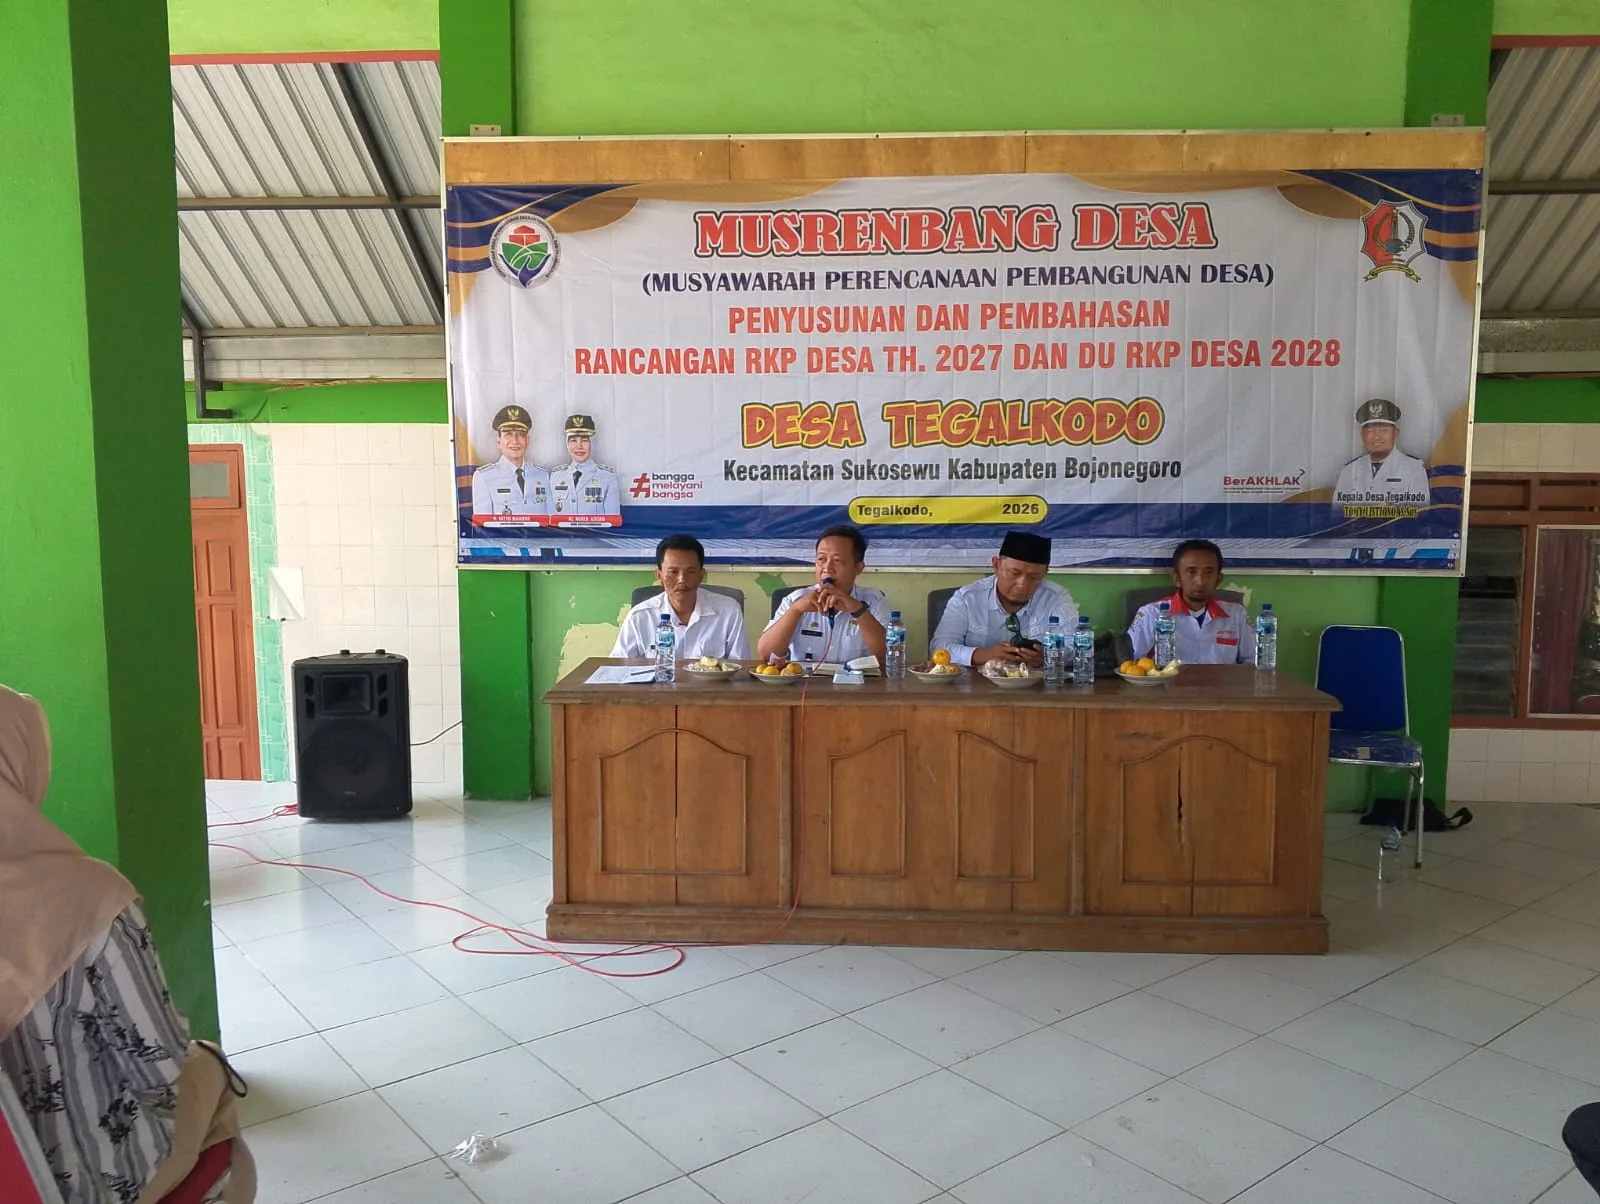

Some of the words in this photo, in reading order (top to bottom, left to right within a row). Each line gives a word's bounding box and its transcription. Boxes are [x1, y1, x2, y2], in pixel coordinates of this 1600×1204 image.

[694, 204, 1061, 257] MUSRENBANG
[1072, 202, 1218, 252] DESA
[642, 269, 816, 296] (MUSYAWARAH
[825, 267, 998, 293] PERENCANAAN
[1006, 265, 1192, 290] PEMBANGUNAN
[1201, 263, 1275, 288] DESA)
[729, 304, 906, 335] PENYUSUNAN
[916, 303, 970, 333] DAN
[980, 300, 1170, 331] PEMBAHASAN
[575, 347, 735, 376] RANCANGAN
[746, 346, 797, 375] RKP
[807, 345, 874, 374] DESA
[884, 344, 926, 373] TH.
[936, 343, 1003, 372] 2027
[1013, 342, 1069, 371] DAN
[1079, 342, 1116, 370] DU
[1126, 341, 1181, 370] RKP
[1191, 340, 1262, 369] DESA
[1271, 339, 1341, 367] 2028
[740, 402, 866, 449] DESA
[882, 397, 1166, 448] TEGALKODO
[652, 472, 695, 482] bangga
[723, 458, 835, 482] Kecamatan
[841, 458, 940, 482] Sukosewu
[948, 457, 1057, 482] Kabupaten
[1064, 456, 1182, 484] Bojonegoro
[652, 481, 703, 491] melayani
[1223, 476, 1300, 486] BerAKHLAK
[652, 491, 694, 500] bangsa
[1337, 491, 1363, 504] Kepala
[1366, 491, 1385, 502] Desa
[1002, 503, 1040, 516] 2026
